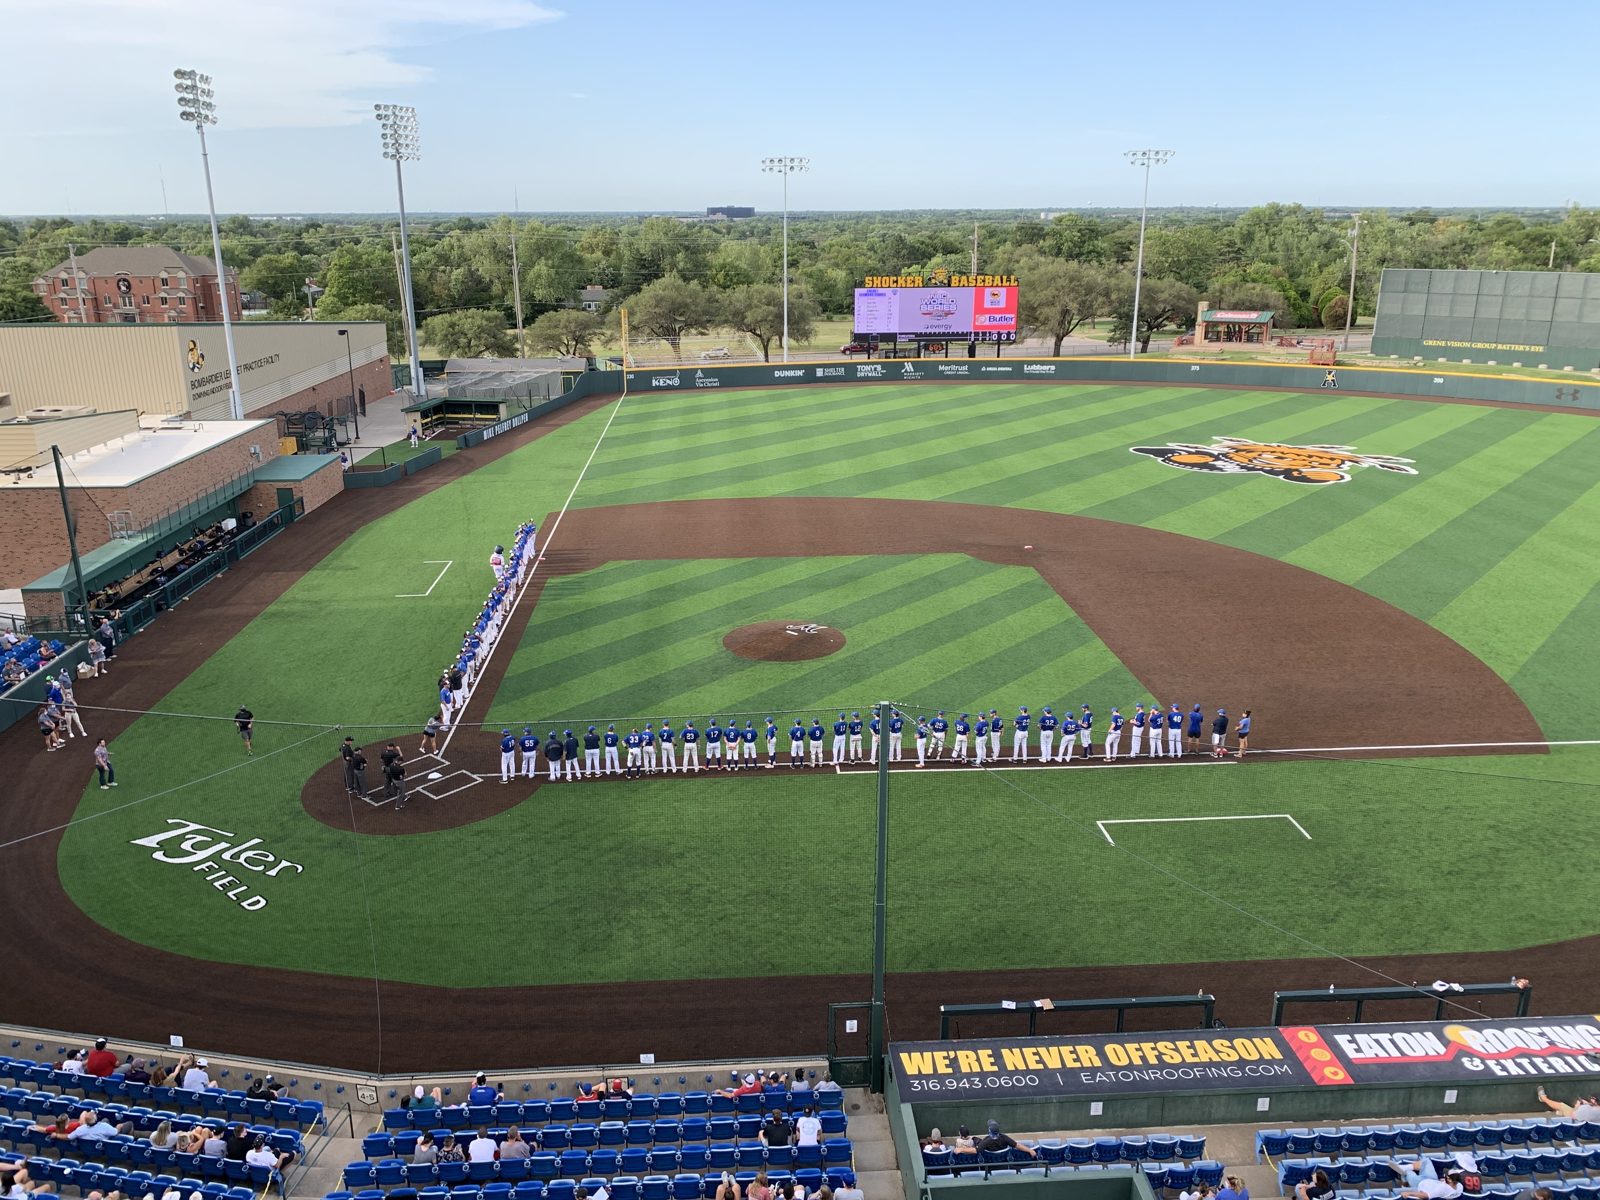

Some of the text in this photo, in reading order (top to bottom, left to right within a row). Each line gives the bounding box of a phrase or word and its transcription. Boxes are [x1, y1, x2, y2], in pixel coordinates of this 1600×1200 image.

[865, 275, 1018, 288] SHOCKER BASEBALL
[988, 315, 1015, 323] Butler
[1497, 343, 1530, 352] BATTER'S
[223, 365, 242, 380] LEAET
[243, 358, 263, 373] PRACTICE
[263, 353, 280, 366] FACILITY
[774, 369, 805, 378] DUNKIN'
[652, 378, 680, 387] KENO
[1045, 719, 1055, 727] 32
[629, 735, 639, 743] 33
[710, 730, 719, 738] 17
[525, 739, 534, 747] 55
[129, 818, 304, 877] Tyler
[193, 861, 268, 912] FIELD
[1333, 1024, 1600, 1058] EATON ROOFING
[899, 1037, 1284, 1076] WE'RE NEVER OFFSEASON
[1461, 1057, 1485, 1071] &
[910, 1064, 1293, 1092] 316.943.0600 EATONROOFING.COM
[1465, 1176, 1480, 1190] 99
